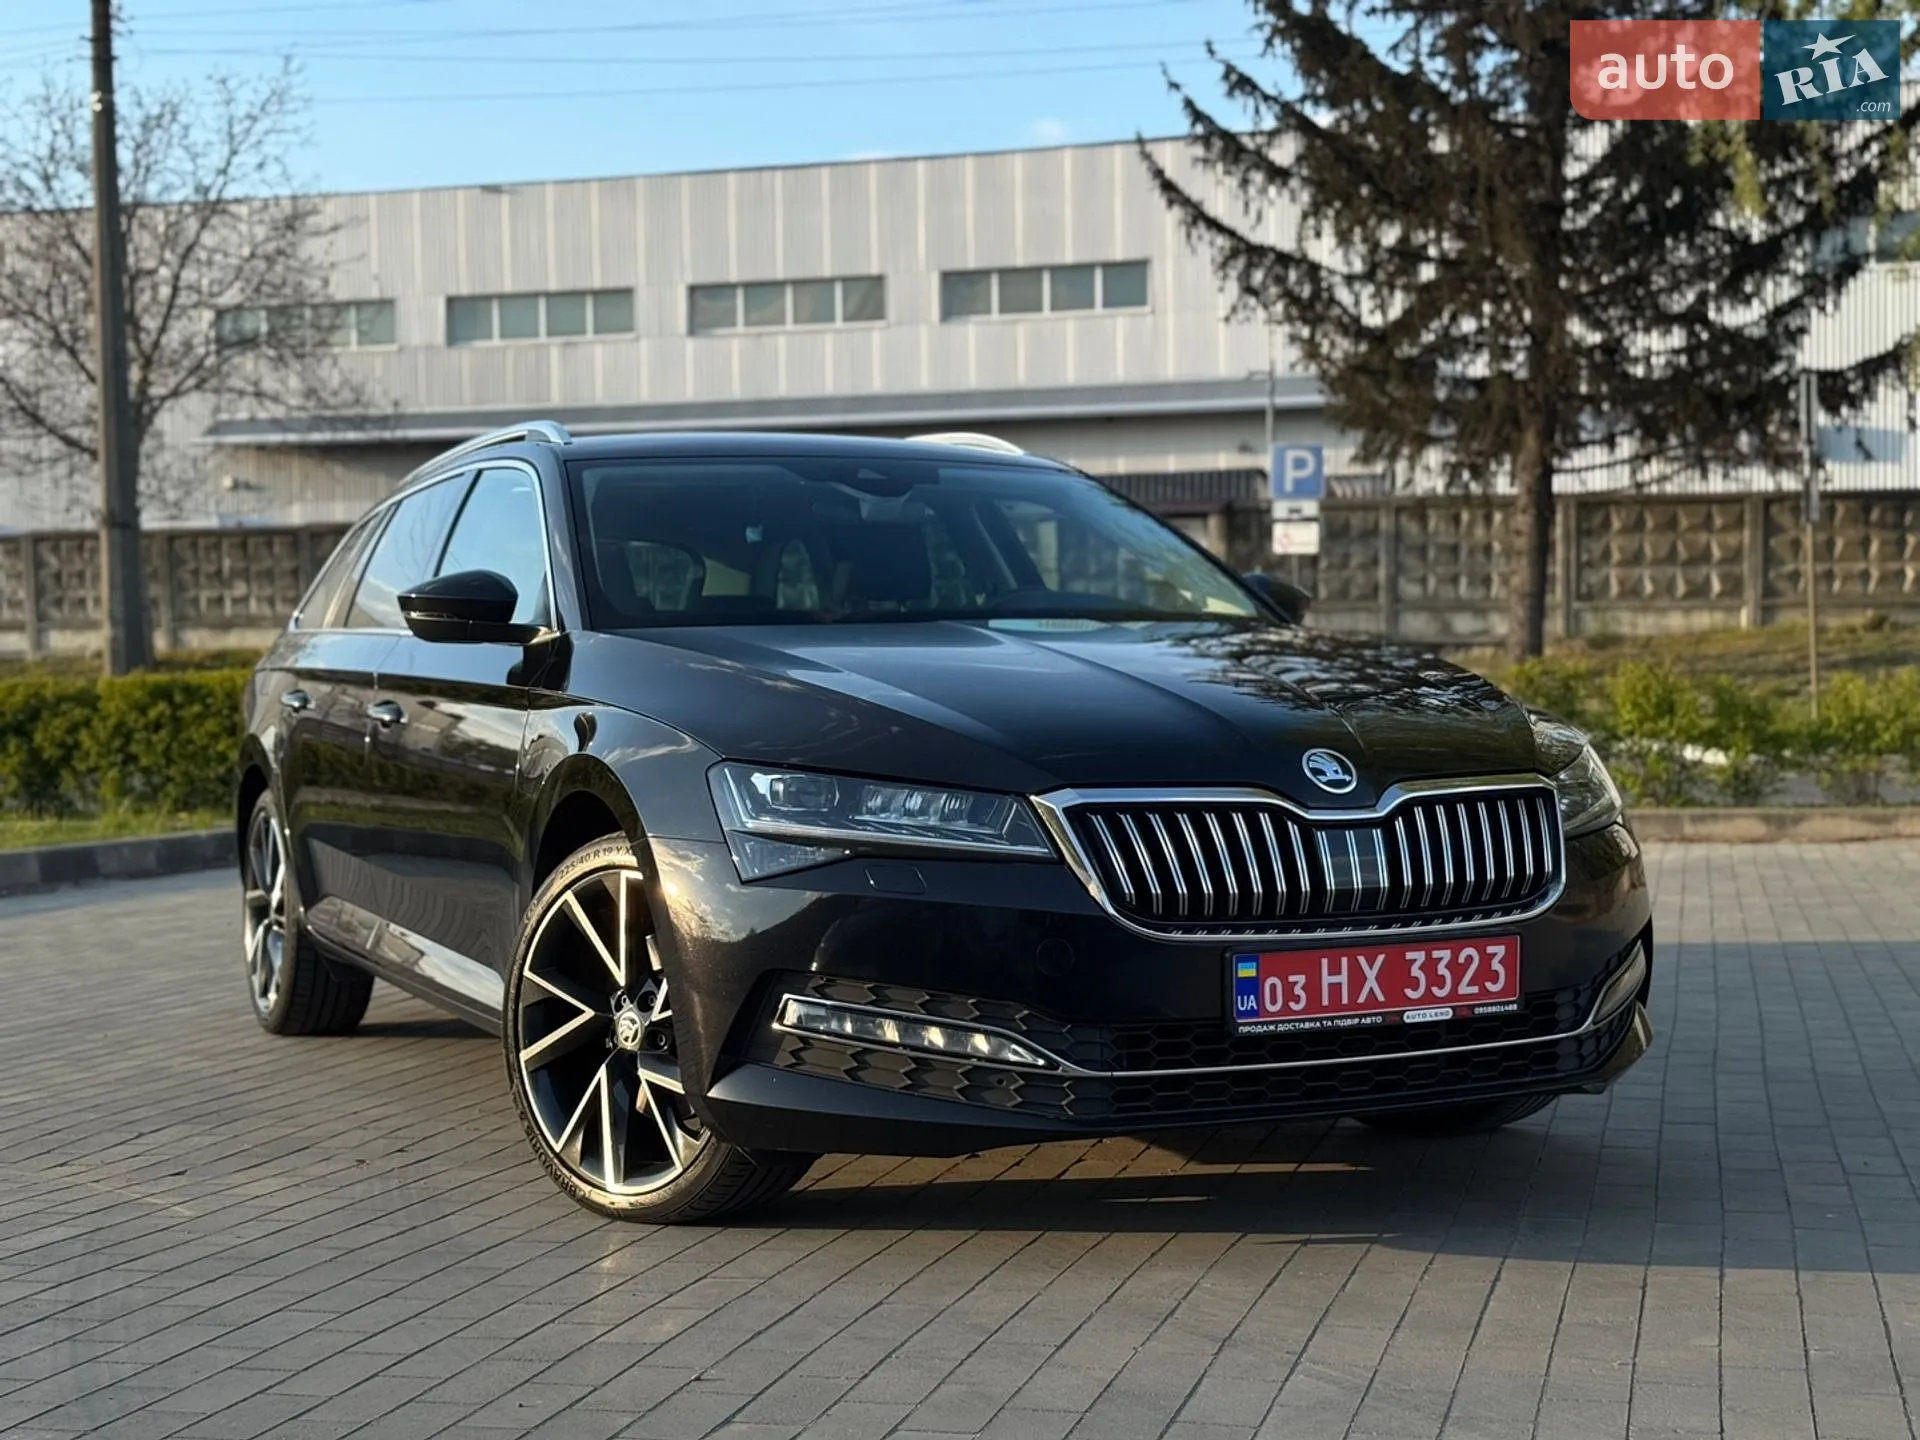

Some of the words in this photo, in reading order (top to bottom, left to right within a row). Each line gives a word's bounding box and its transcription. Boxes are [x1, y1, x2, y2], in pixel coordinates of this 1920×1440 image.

[1283, 449, 1317, 494] P
[1263, 974, 1306, 1013] 03
[1320, 953, 1386, 1006] HX
[1402, 944, 1507, 1000] 3323
[1237, 993, 1258, 1012] UA
